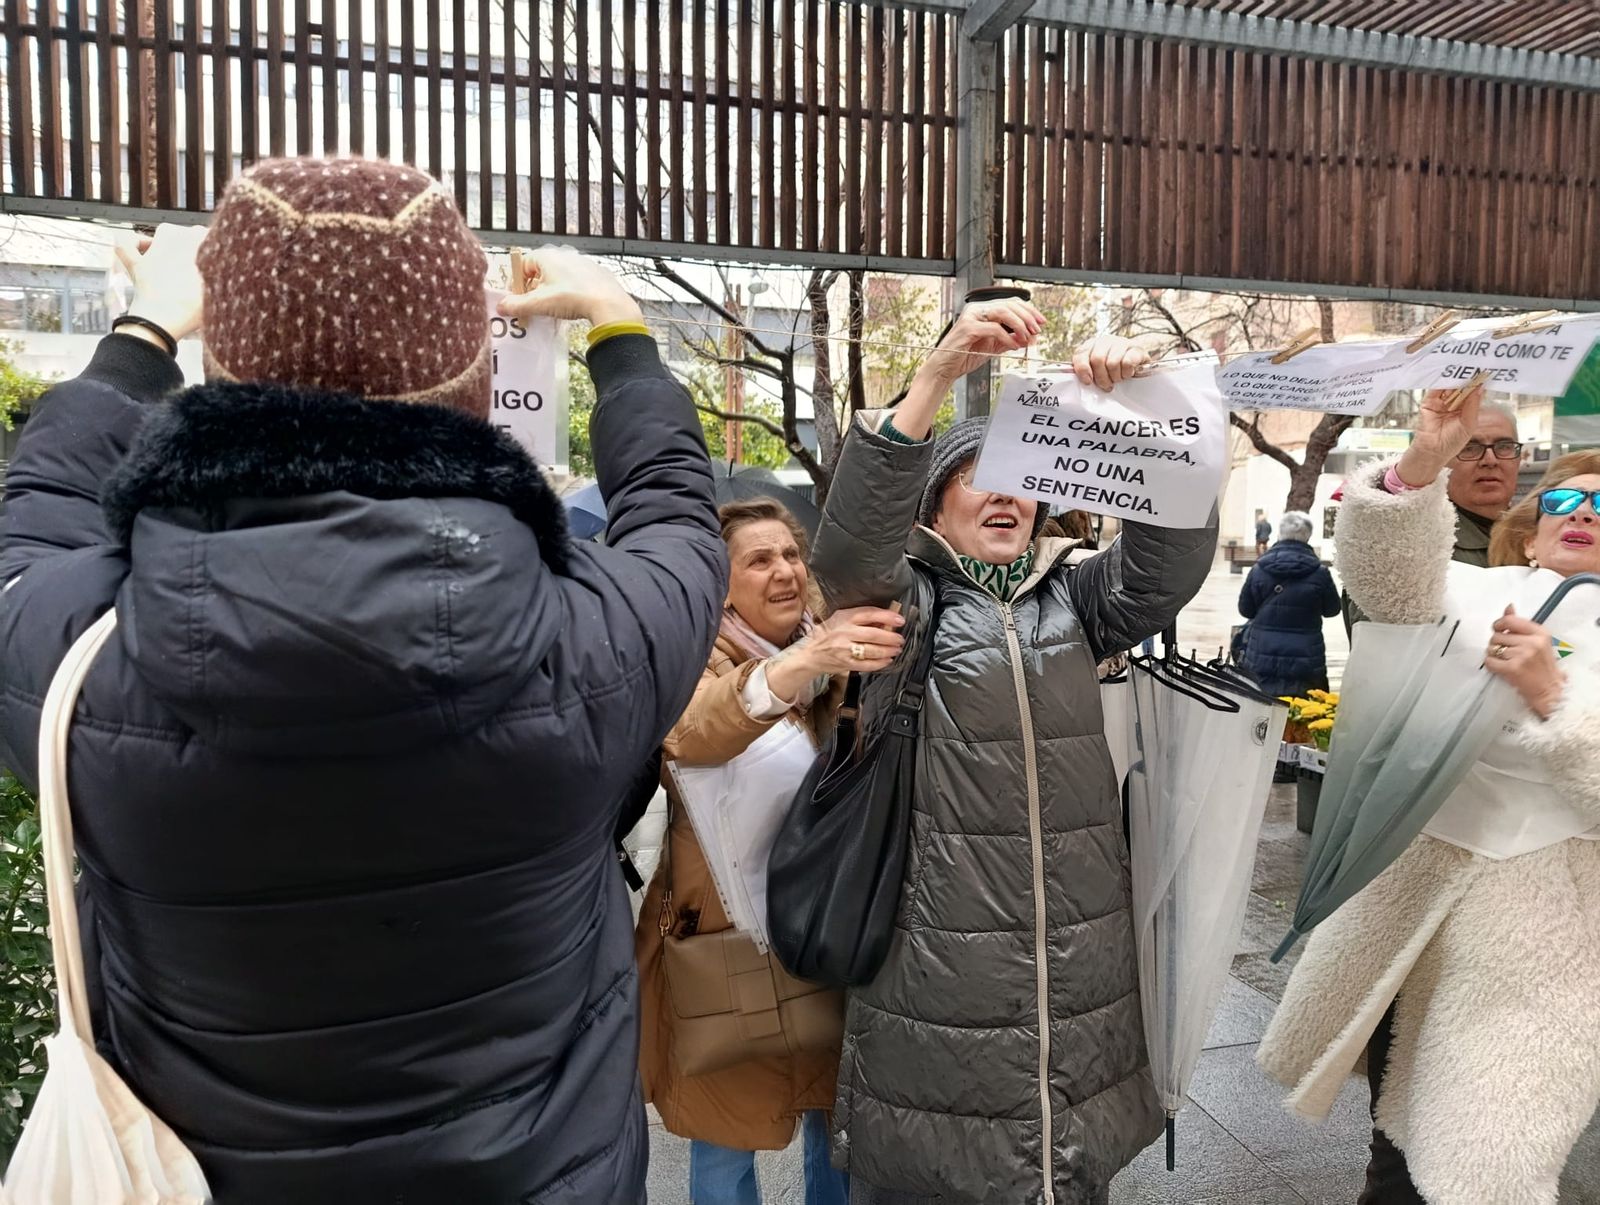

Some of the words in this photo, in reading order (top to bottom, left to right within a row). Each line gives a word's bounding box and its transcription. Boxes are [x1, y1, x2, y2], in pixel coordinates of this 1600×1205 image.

[490, 317, 527, 339] OS
[1430, 340, 1491, 357] ECIDIR
[1494, 339, 1546, 359] CÓMO
[1550, 346, 1574, 360] TE
[1241, 372, 1269, 380] QUE
[1252, 382, 1278, 390] QUE
[493, 389, 543, 411] IGO
[1017, 390, 1060, 407] AZAYCA
[1242, 391, 1269, 399] QUE
[1030, 413, 1060, 427] EL
[1068, 417, 1167, 438] CÁNCER
[1169, 416, 1200, 436] ES
[1021, 431, 1071, 448] UNA
[1077, 439, 1197, 466] PALABRA,
[1053, 456, 1090, 474] NO
[1096, 461, 1145, 485] UNA
[1022, 475, 1159, 516] SENTENCIA.
